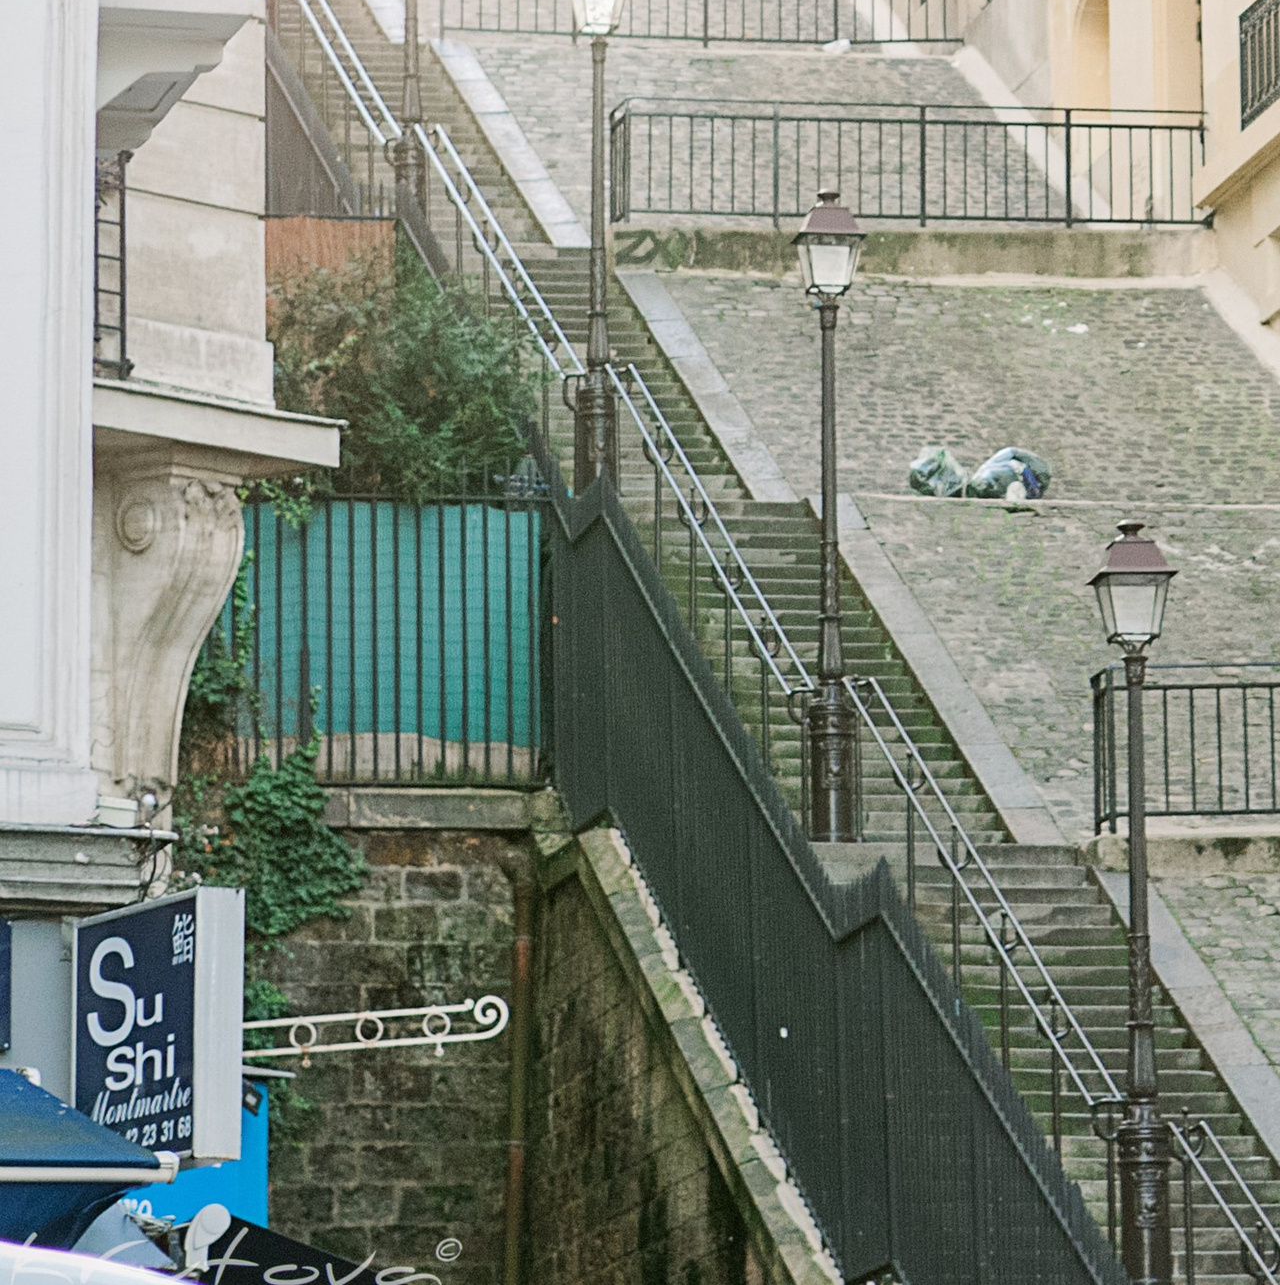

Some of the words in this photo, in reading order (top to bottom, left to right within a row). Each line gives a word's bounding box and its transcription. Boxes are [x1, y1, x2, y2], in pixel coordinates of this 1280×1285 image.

[87, 936, 163, 1046] Su
[91, 1077, 191, 1126] Montmartre
[141, 1124, 157, 1146] 23
[161, 1119, 174, 1142] 31
[178, 1115, 191, 1138] 68
